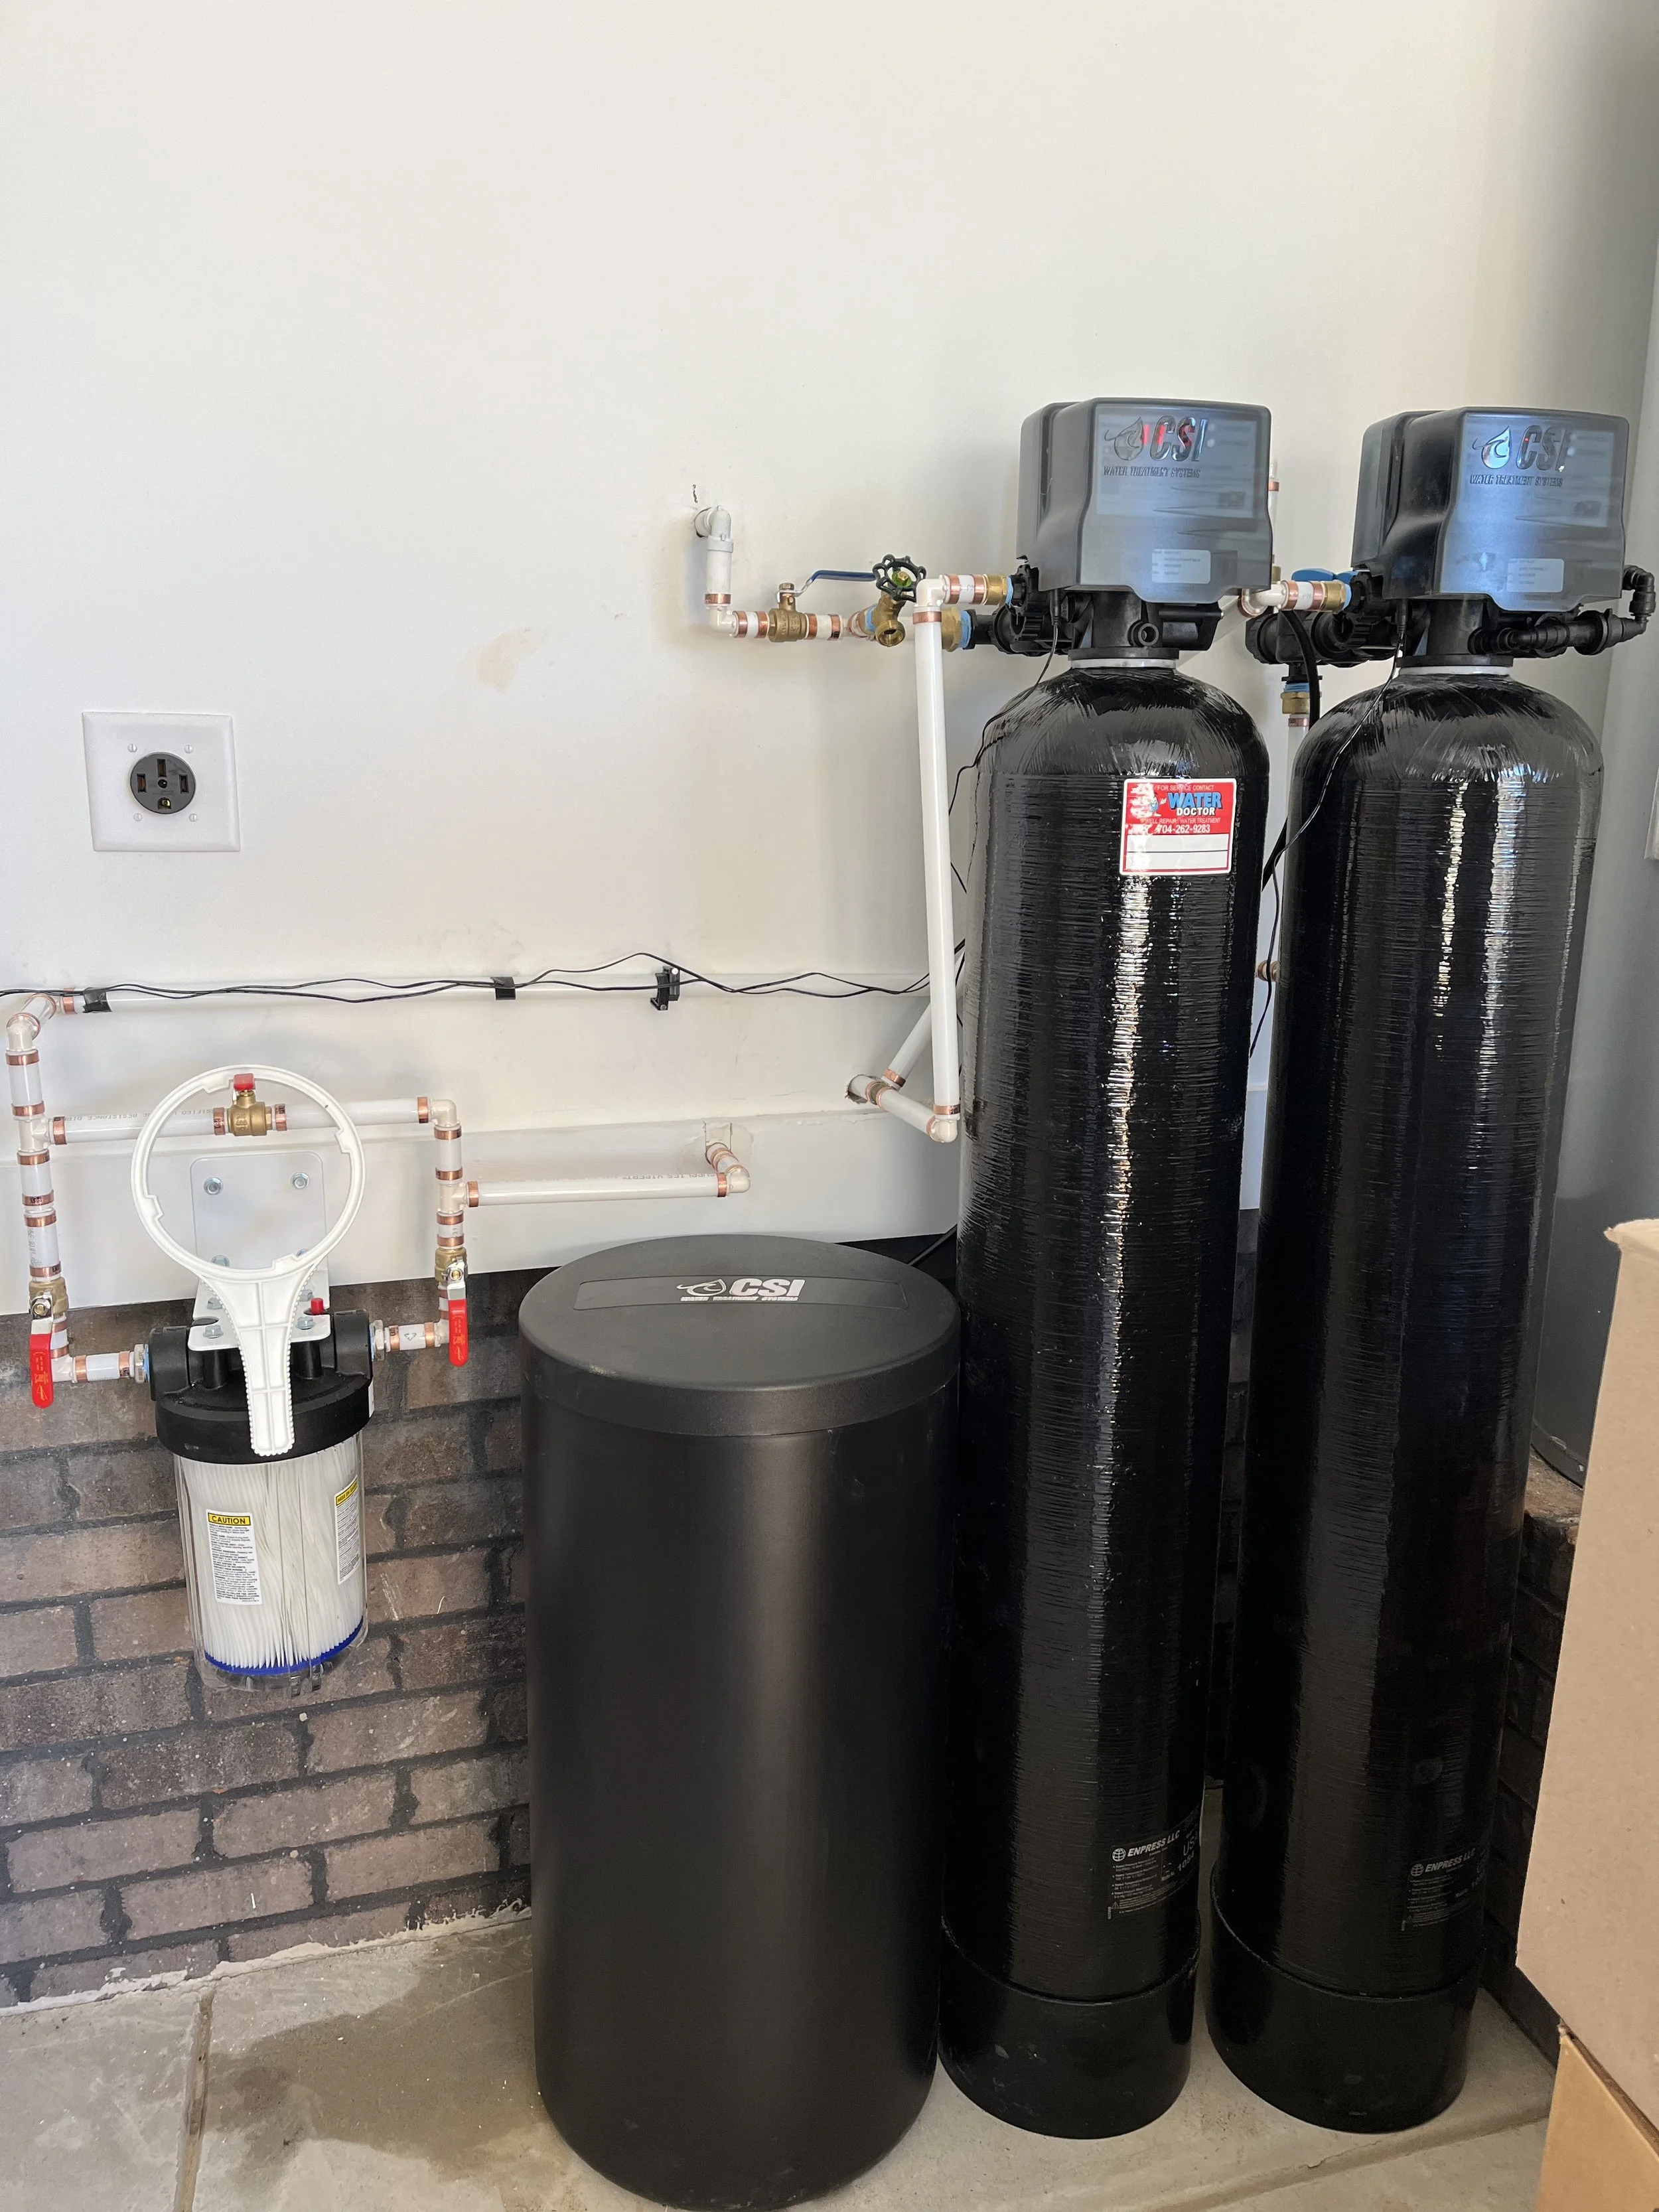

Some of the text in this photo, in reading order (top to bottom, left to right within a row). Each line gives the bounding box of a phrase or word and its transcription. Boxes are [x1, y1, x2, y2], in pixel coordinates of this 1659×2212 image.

[1150, 415, 1208, 461] CSI
[1516, 425, 1567, 471] CSI
[1167, 792, 1222, 808] WATER
[1177, 807, 1216, 816] DOCTOR
[1157, 824, 1210, 834] 704-262-9283
[729, 1278, 805, 1297] CSI
[212, 1515, 246, 1524] CAUTION
[1127, 1837, 1167, 1857] ENPRESS
[1167, 1830, 1181, 1844] LLC
[1425, 1856, 1463, 1873] ENPRESS
